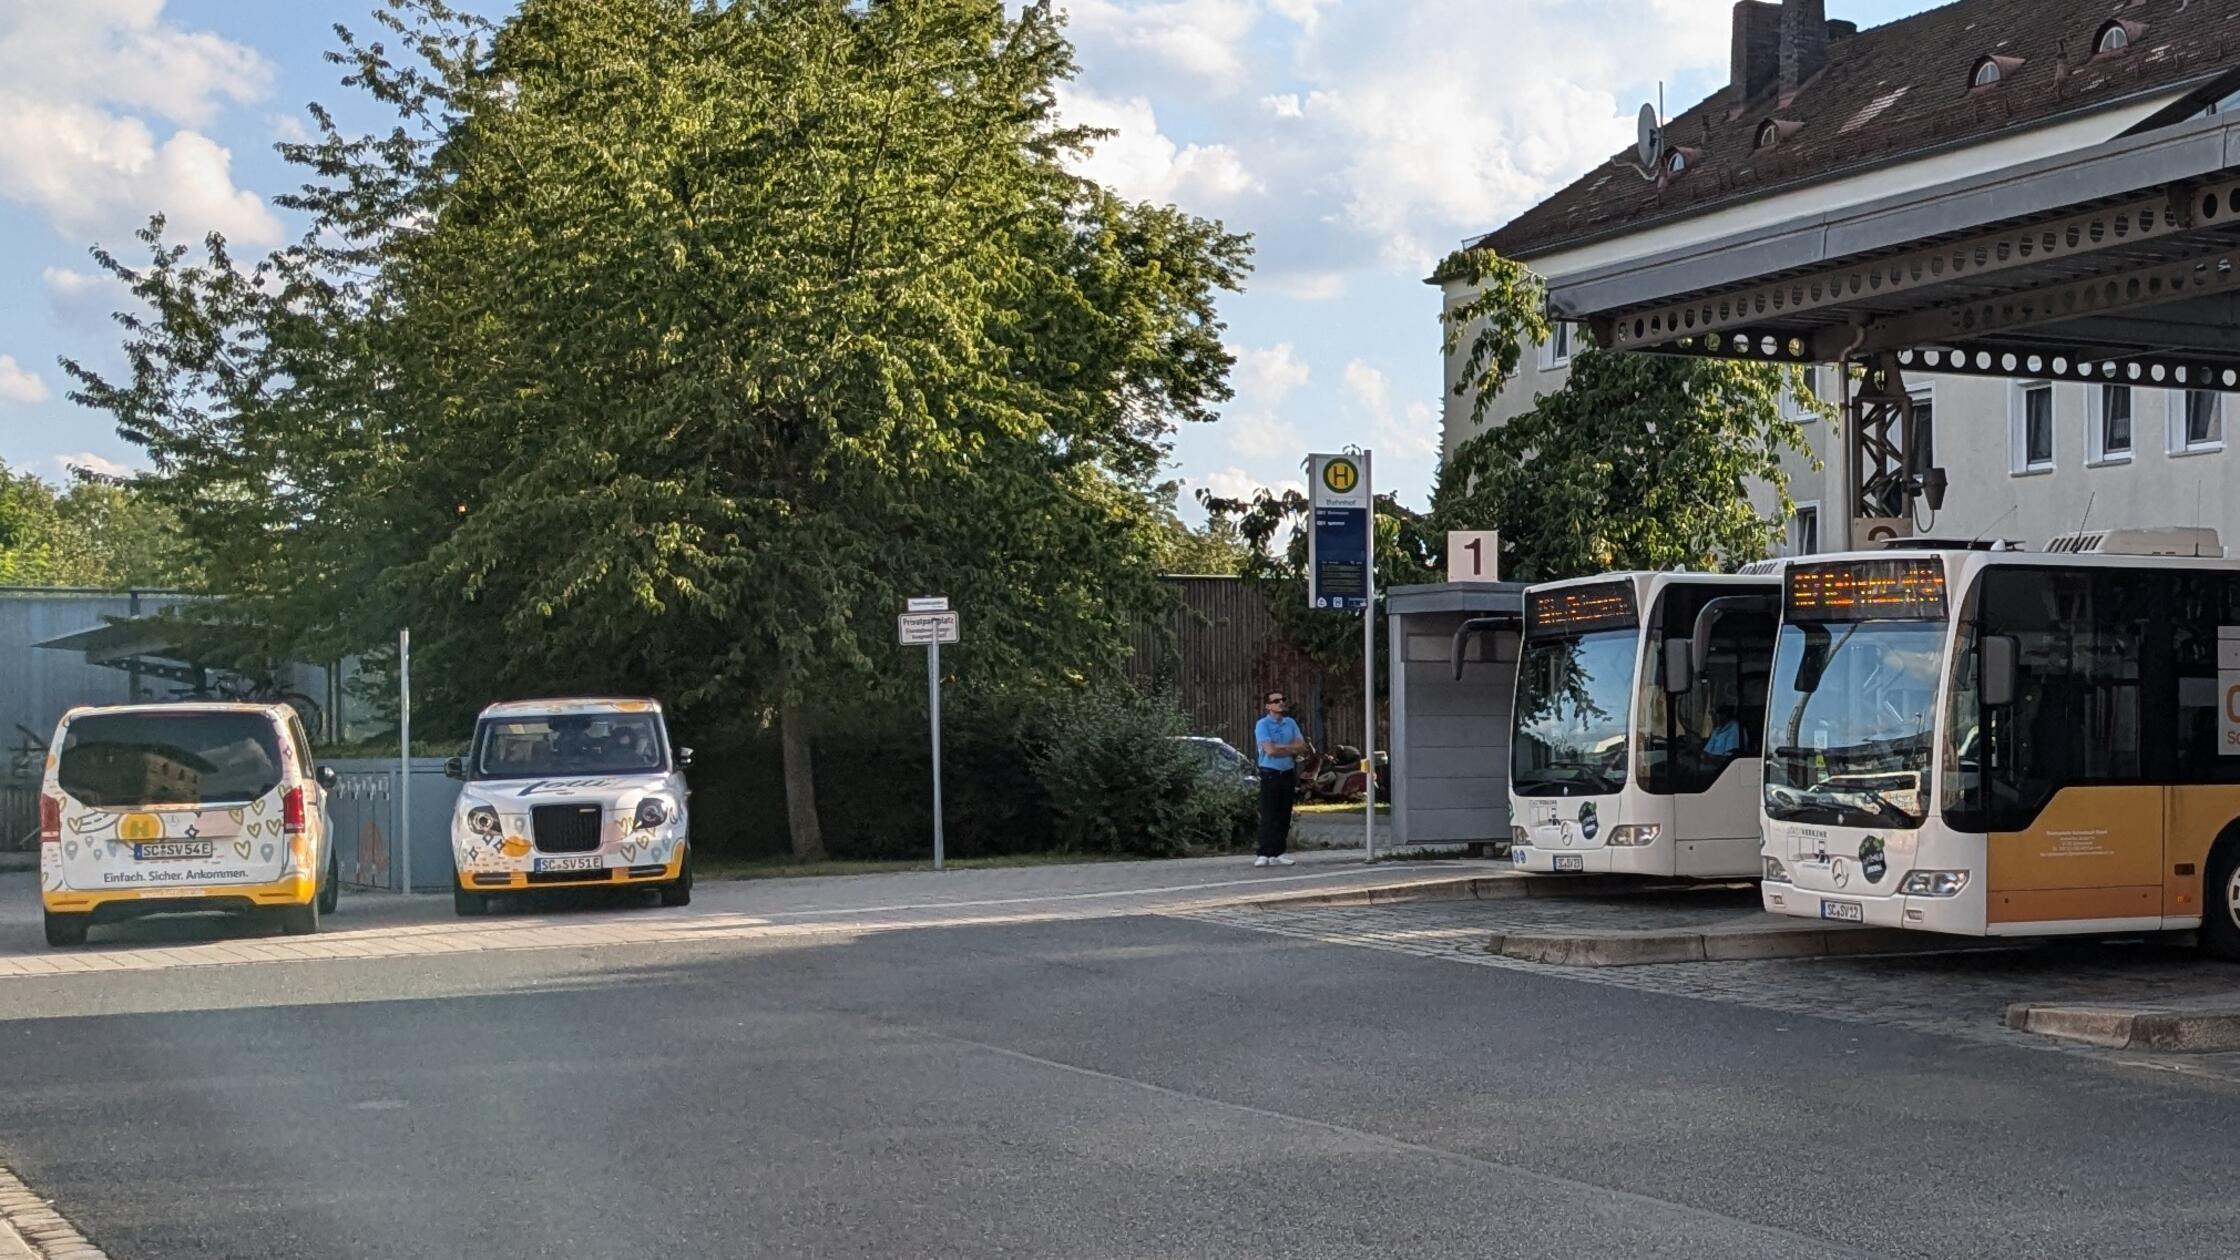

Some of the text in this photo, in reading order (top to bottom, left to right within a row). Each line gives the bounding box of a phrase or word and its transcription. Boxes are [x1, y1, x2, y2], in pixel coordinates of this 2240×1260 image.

[1333, 466, 1348, 486] H
[1464, 537, 1481, 575] 1
[103, 868, 248, 883] Einfach. Sicher. Ankommen.
